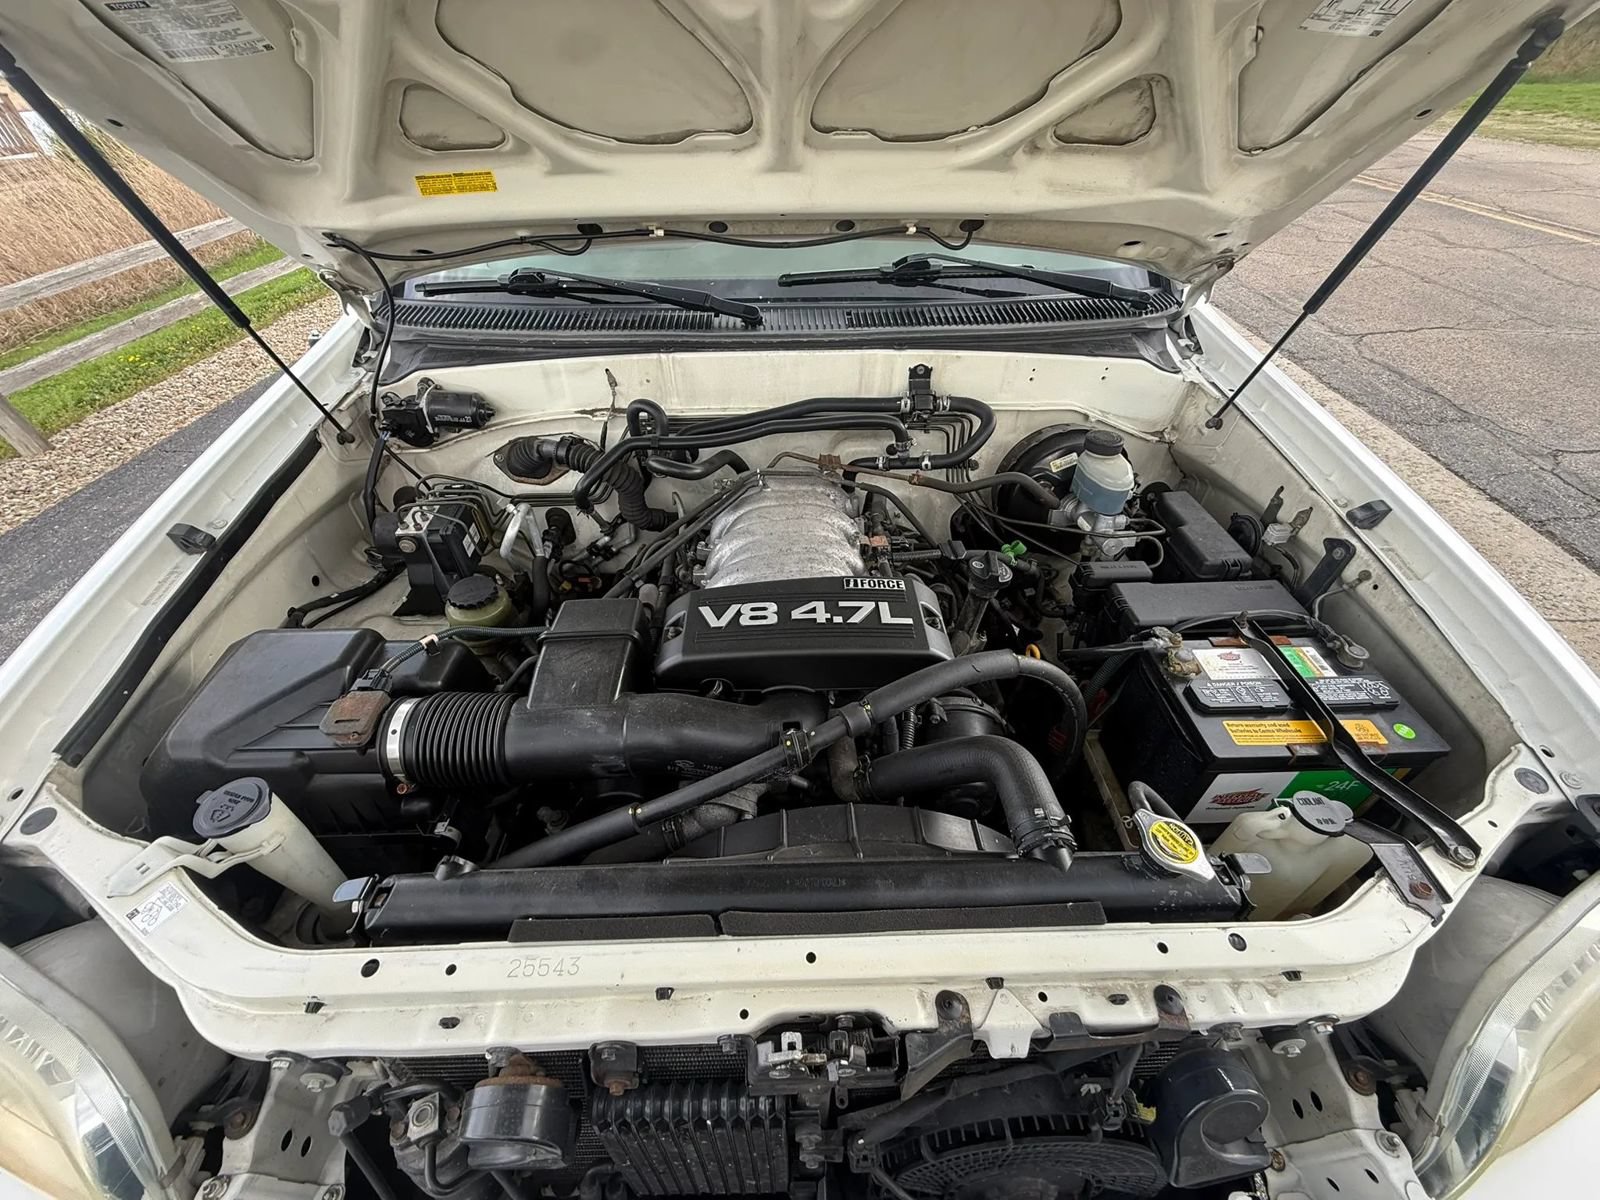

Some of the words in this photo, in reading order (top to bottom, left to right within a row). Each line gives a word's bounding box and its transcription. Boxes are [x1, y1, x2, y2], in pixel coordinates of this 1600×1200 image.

[110, 2, 147, 10] TOYOTA
[698, 602, 778, 628] V8
[791, 601, 914, 625] 4.7L
[1324, 780, 1360, 791] 24F
[1169, 823, 1194, 846] CAUTION
[507, 956, 582, 978] 25543
